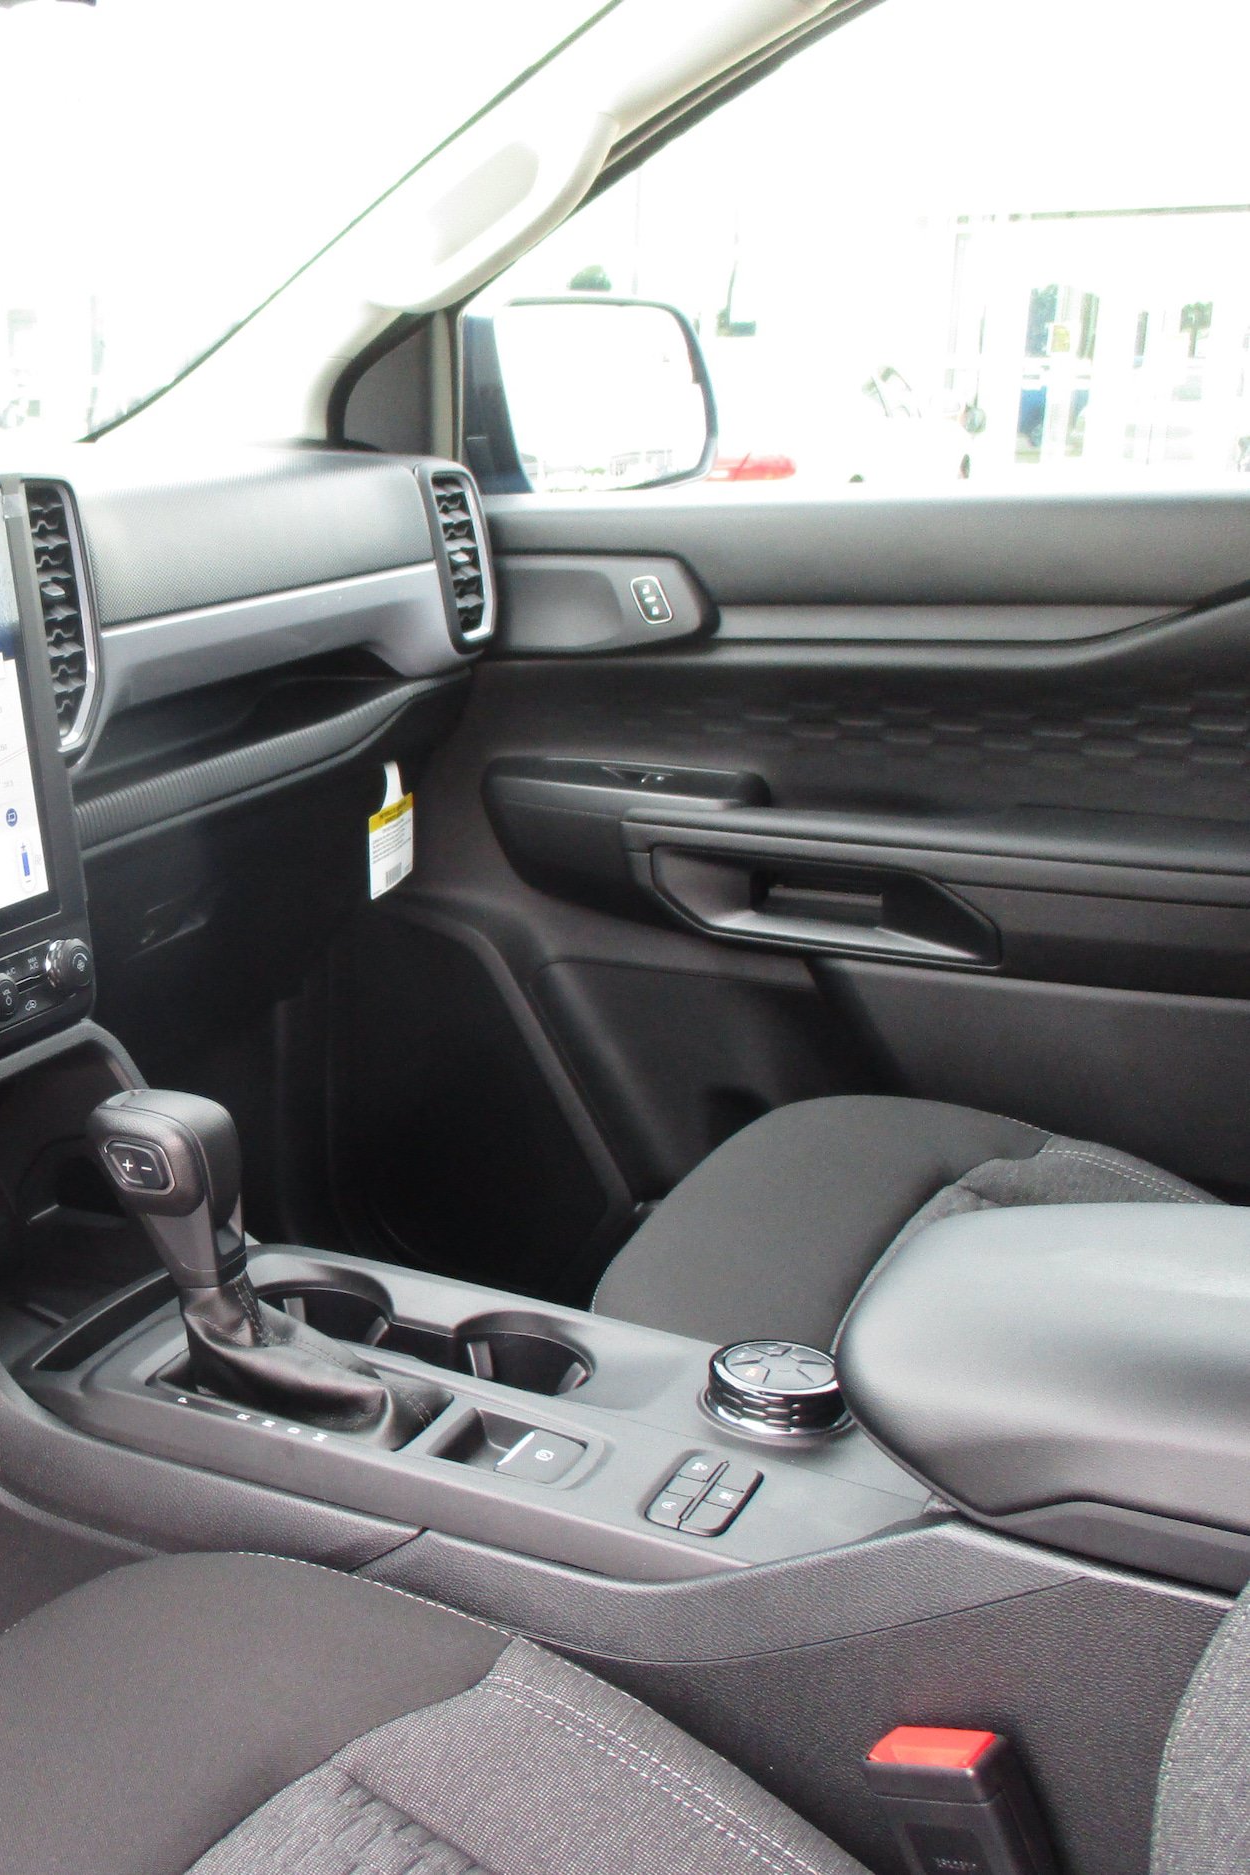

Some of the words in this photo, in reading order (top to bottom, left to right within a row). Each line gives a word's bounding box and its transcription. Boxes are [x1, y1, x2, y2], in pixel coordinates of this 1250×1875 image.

[177, 1396, 188, 1404] P
[237, 1413, 250, 1421] R
[262, 1419, 276, 1428] N
[287, 1426, 300, 1435] D
